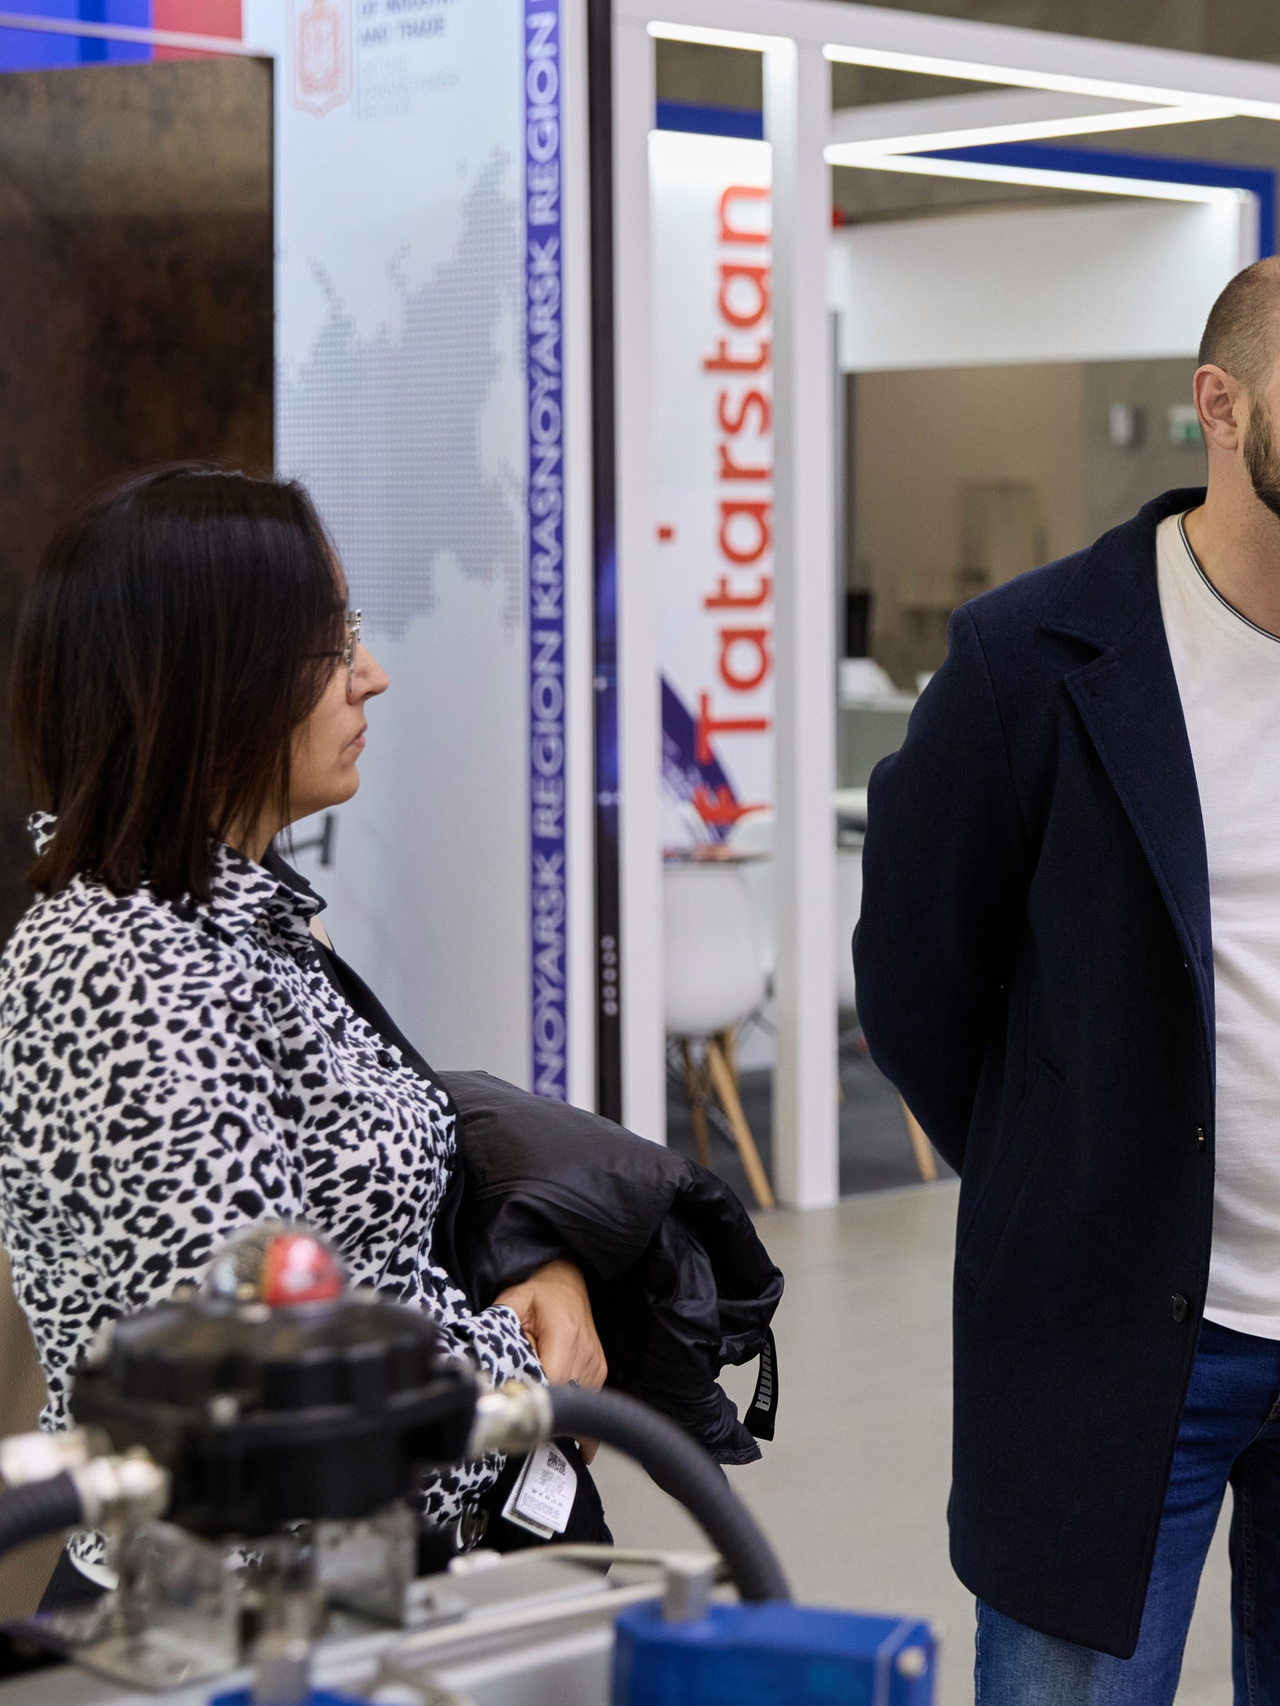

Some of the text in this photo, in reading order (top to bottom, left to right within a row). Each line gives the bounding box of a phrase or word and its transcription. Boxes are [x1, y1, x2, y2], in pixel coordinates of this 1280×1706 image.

[525, 10, 566, 1099] NOYARSK REGION KRASNOYARSK REGION
[695, 183, 772, 766] Tatarstan
[755, 1342, 772, 1411] PUMA
